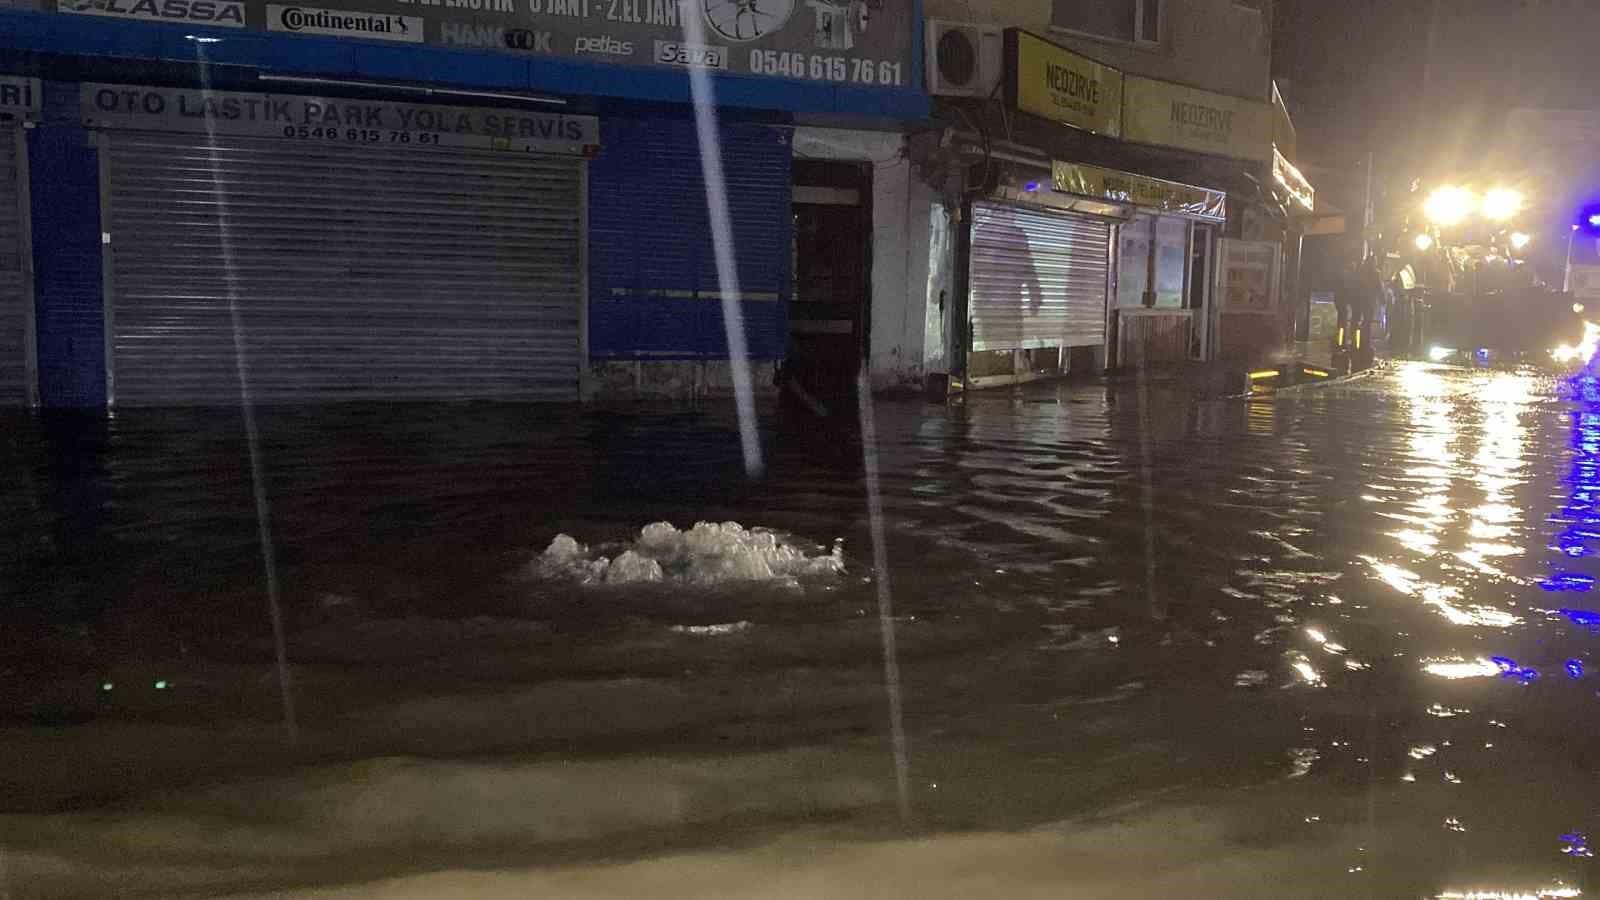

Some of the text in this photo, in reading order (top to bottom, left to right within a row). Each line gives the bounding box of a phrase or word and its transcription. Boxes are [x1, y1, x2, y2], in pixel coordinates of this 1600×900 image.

[104, 0, 244, 23] LASSA
[281, 7, 391, 33] Continental
[575, 35, 634, 56] petlas
[749, 48, 902, 86] 0546 615 76 61
[95, 88, 165, 115] OTO
[178, 94, 291, 122] LASTİK
[303, 102, 382, 128] PARK
[484, 114, 583, 141] SERVİS
[283, 125, 440, 145] 0546 615 76 61
